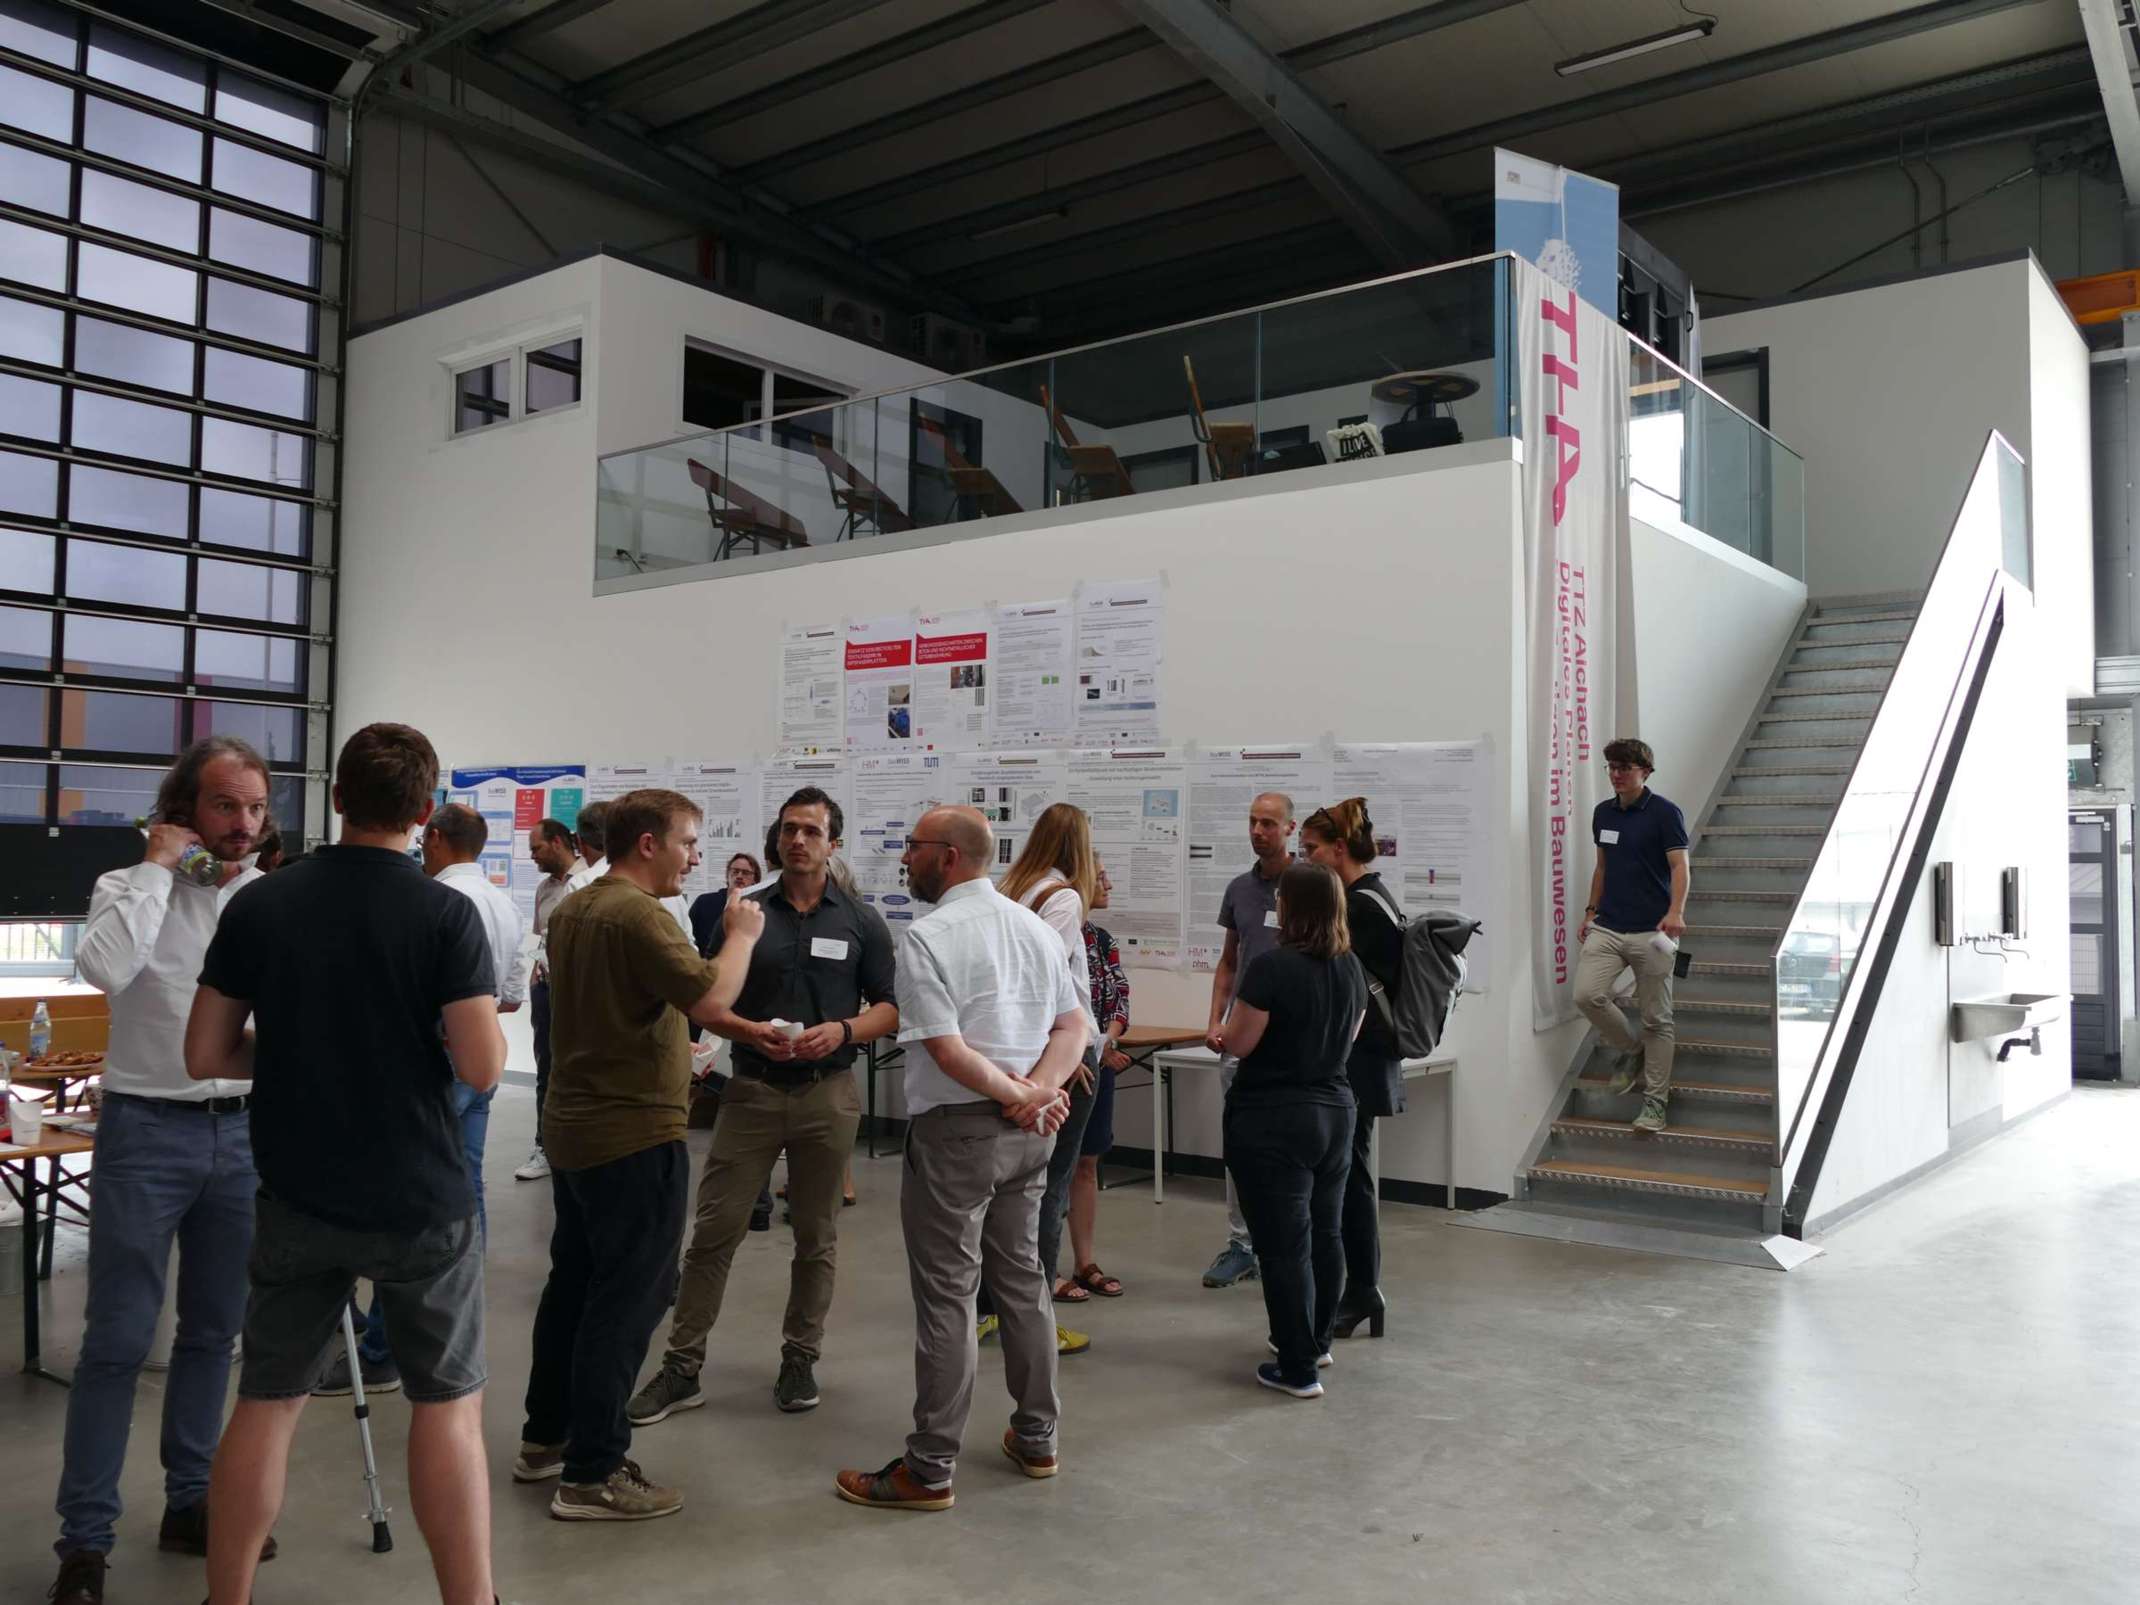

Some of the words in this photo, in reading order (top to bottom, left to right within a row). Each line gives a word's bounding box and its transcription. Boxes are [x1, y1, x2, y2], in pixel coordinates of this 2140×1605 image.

[1573, 566, 1586, 628] TTZ
[1575, 633, 1592, 761] Aichach
[1549, 768, 1563, 807] im
[1550, 816, 1568, 985] Bauwesen
